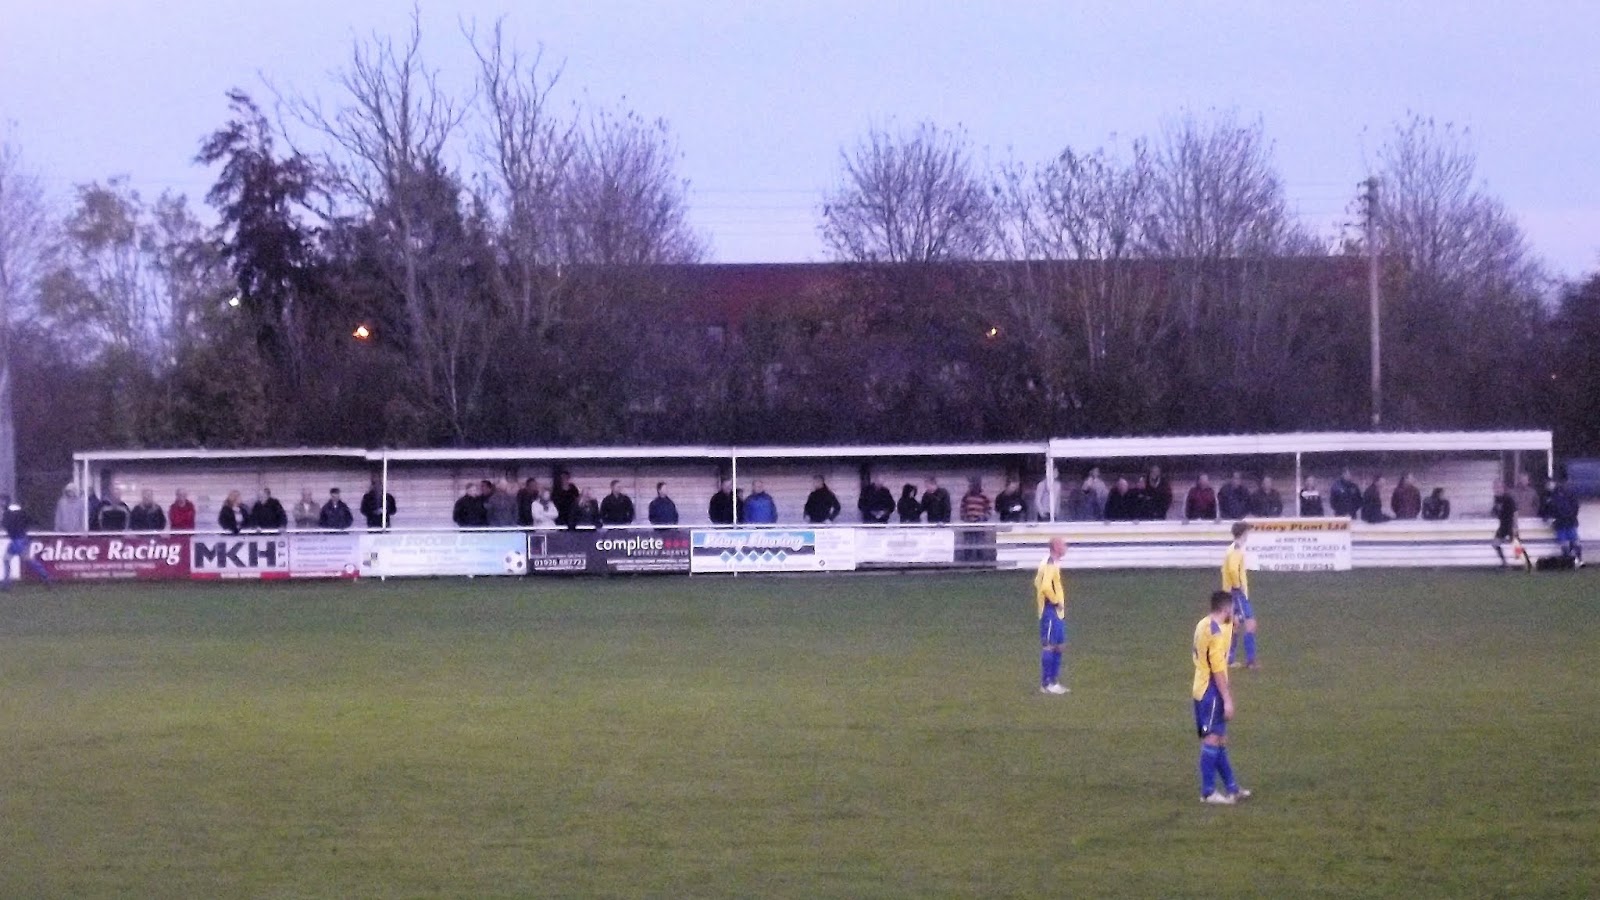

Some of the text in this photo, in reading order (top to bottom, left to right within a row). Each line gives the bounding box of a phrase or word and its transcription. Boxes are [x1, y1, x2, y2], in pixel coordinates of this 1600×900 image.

[1290, 522, 1323, 531] Plant
[1327, 522, 1348, 531] Ltd
[29, 539, 181, 565] Palace Racing
[194, 541, 276, 568] MKH
[595, 536, 664, 556] complete
